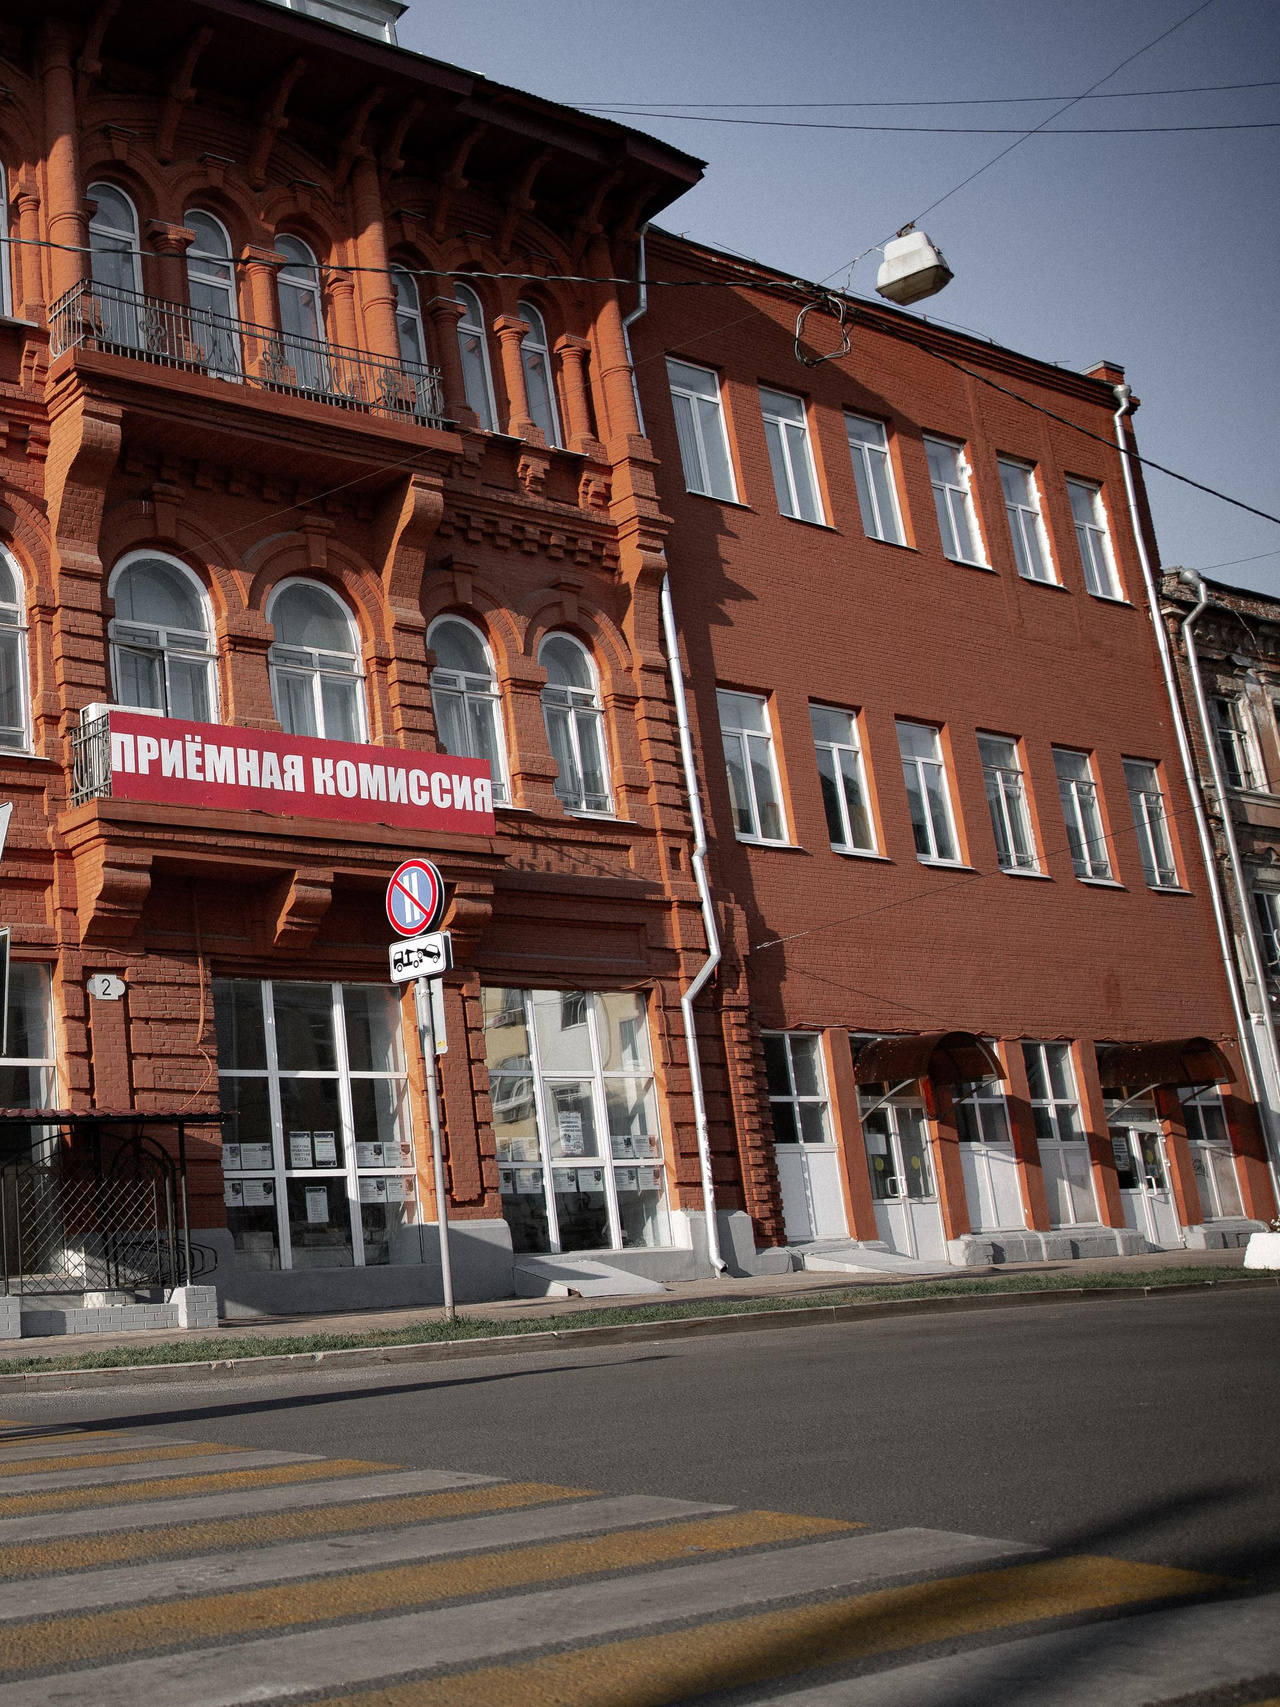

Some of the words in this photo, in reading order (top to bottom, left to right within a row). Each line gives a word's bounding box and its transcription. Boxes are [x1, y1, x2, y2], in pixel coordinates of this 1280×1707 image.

[111, 732, 305, 793] ПРИЁМНАЯ
[312, 757, 494, 813] КОМИССИЯ
[101, 978, 112, 996] 2
